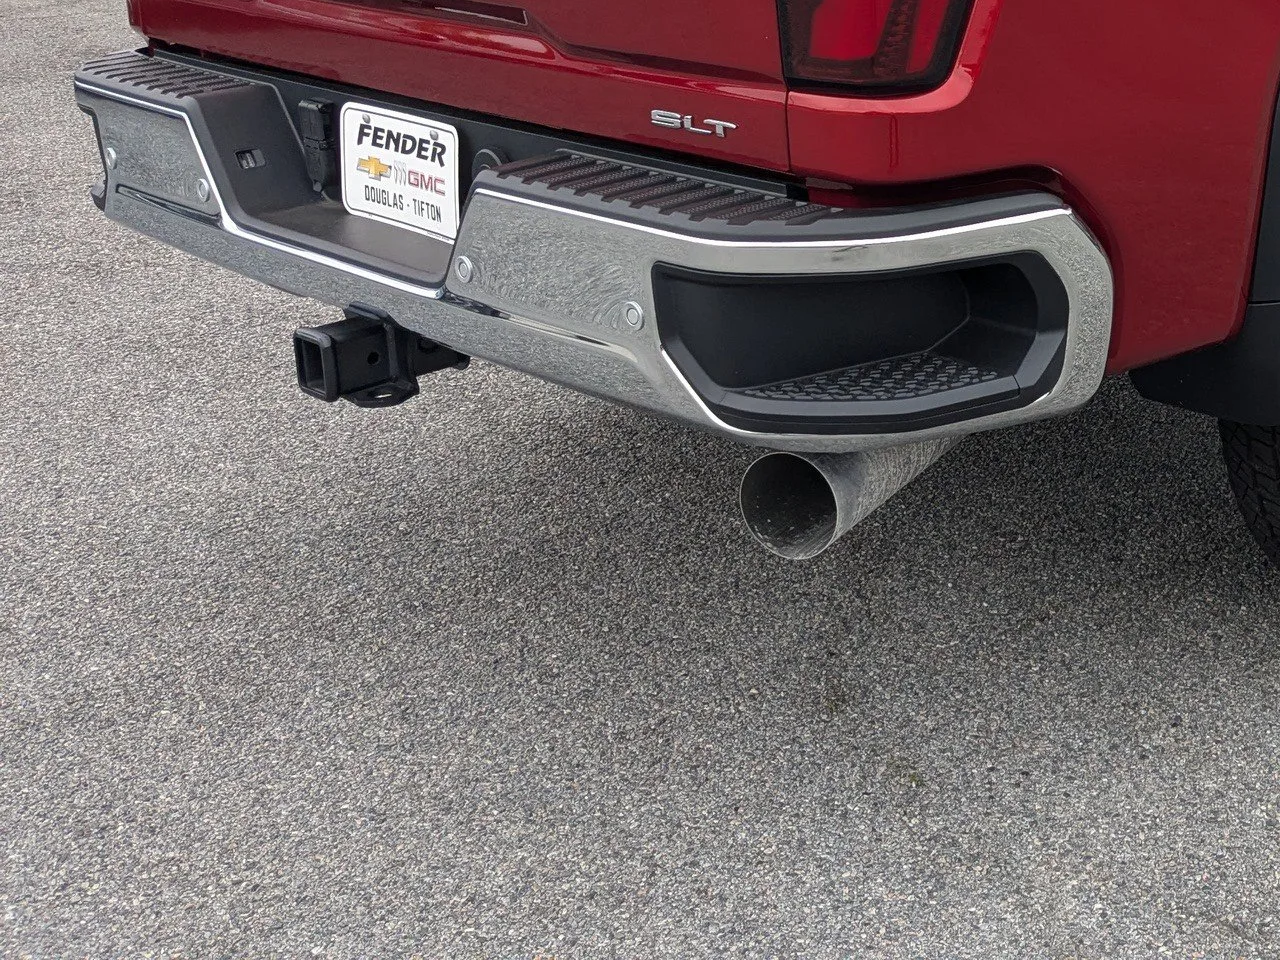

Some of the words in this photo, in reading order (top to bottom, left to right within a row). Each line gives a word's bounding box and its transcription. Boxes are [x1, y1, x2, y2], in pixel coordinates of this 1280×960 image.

[650, 109, 738, 138] SLT
[356, 123, 447, 168] FENDER
[407, 169, 446, 197] GMC
[364, 184, 404, 211] DOUGLAS
[412, 198, 442, 224] TIFTON
